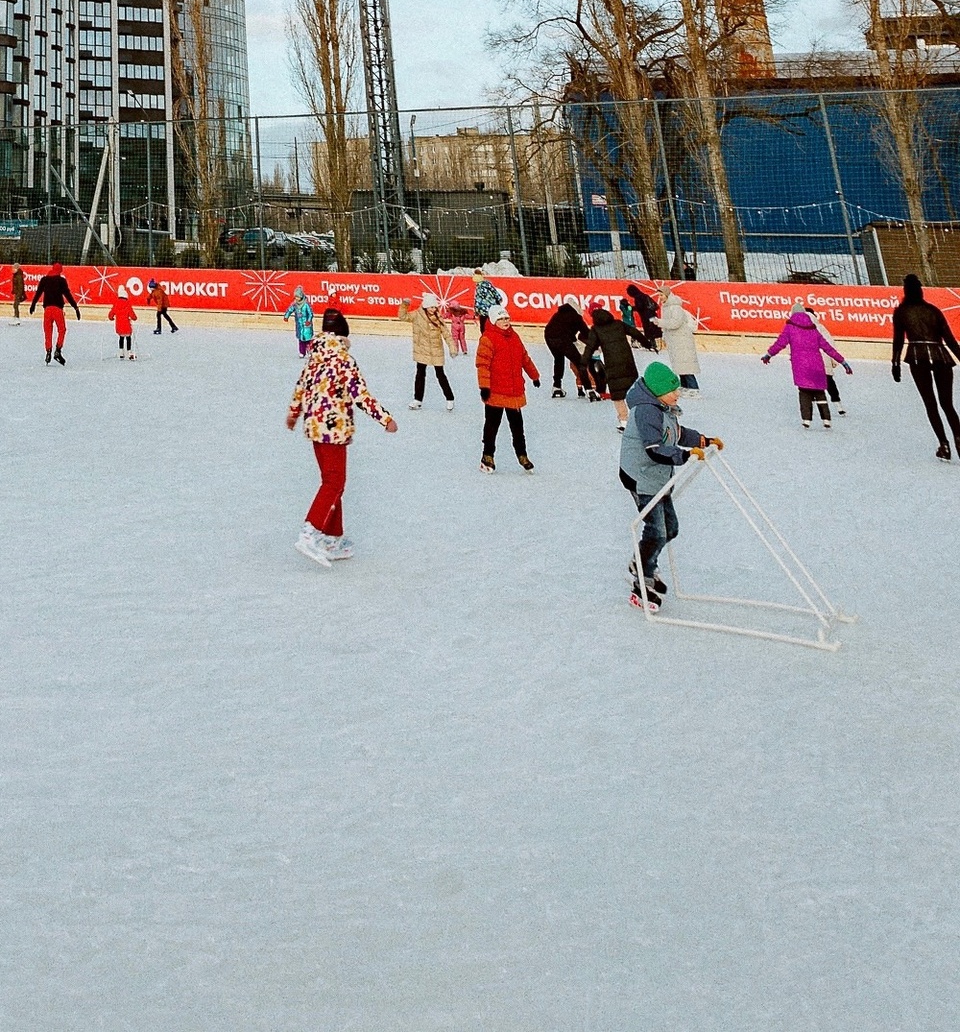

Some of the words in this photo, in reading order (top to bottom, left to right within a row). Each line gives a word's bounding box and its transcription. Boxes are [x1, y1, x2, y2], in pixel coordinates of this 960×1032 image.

[321, 280, 360, 294] Потому
[361, 284, 380, 292] что
[306, 294, 355, 305] празик
[367, 296, 386, 305] это
[388, 296, 402, 305] вы
[719, 290, 792, 307] Продукты
[794, 295, 804, 305] с
[806, 293, 900, 309] бесплатной
[730, 307, 793, 321] доставк
[816, 310, 828, 321] от
[829, 308, 844, 321] 15
[847, 313, 894, 326] минут
